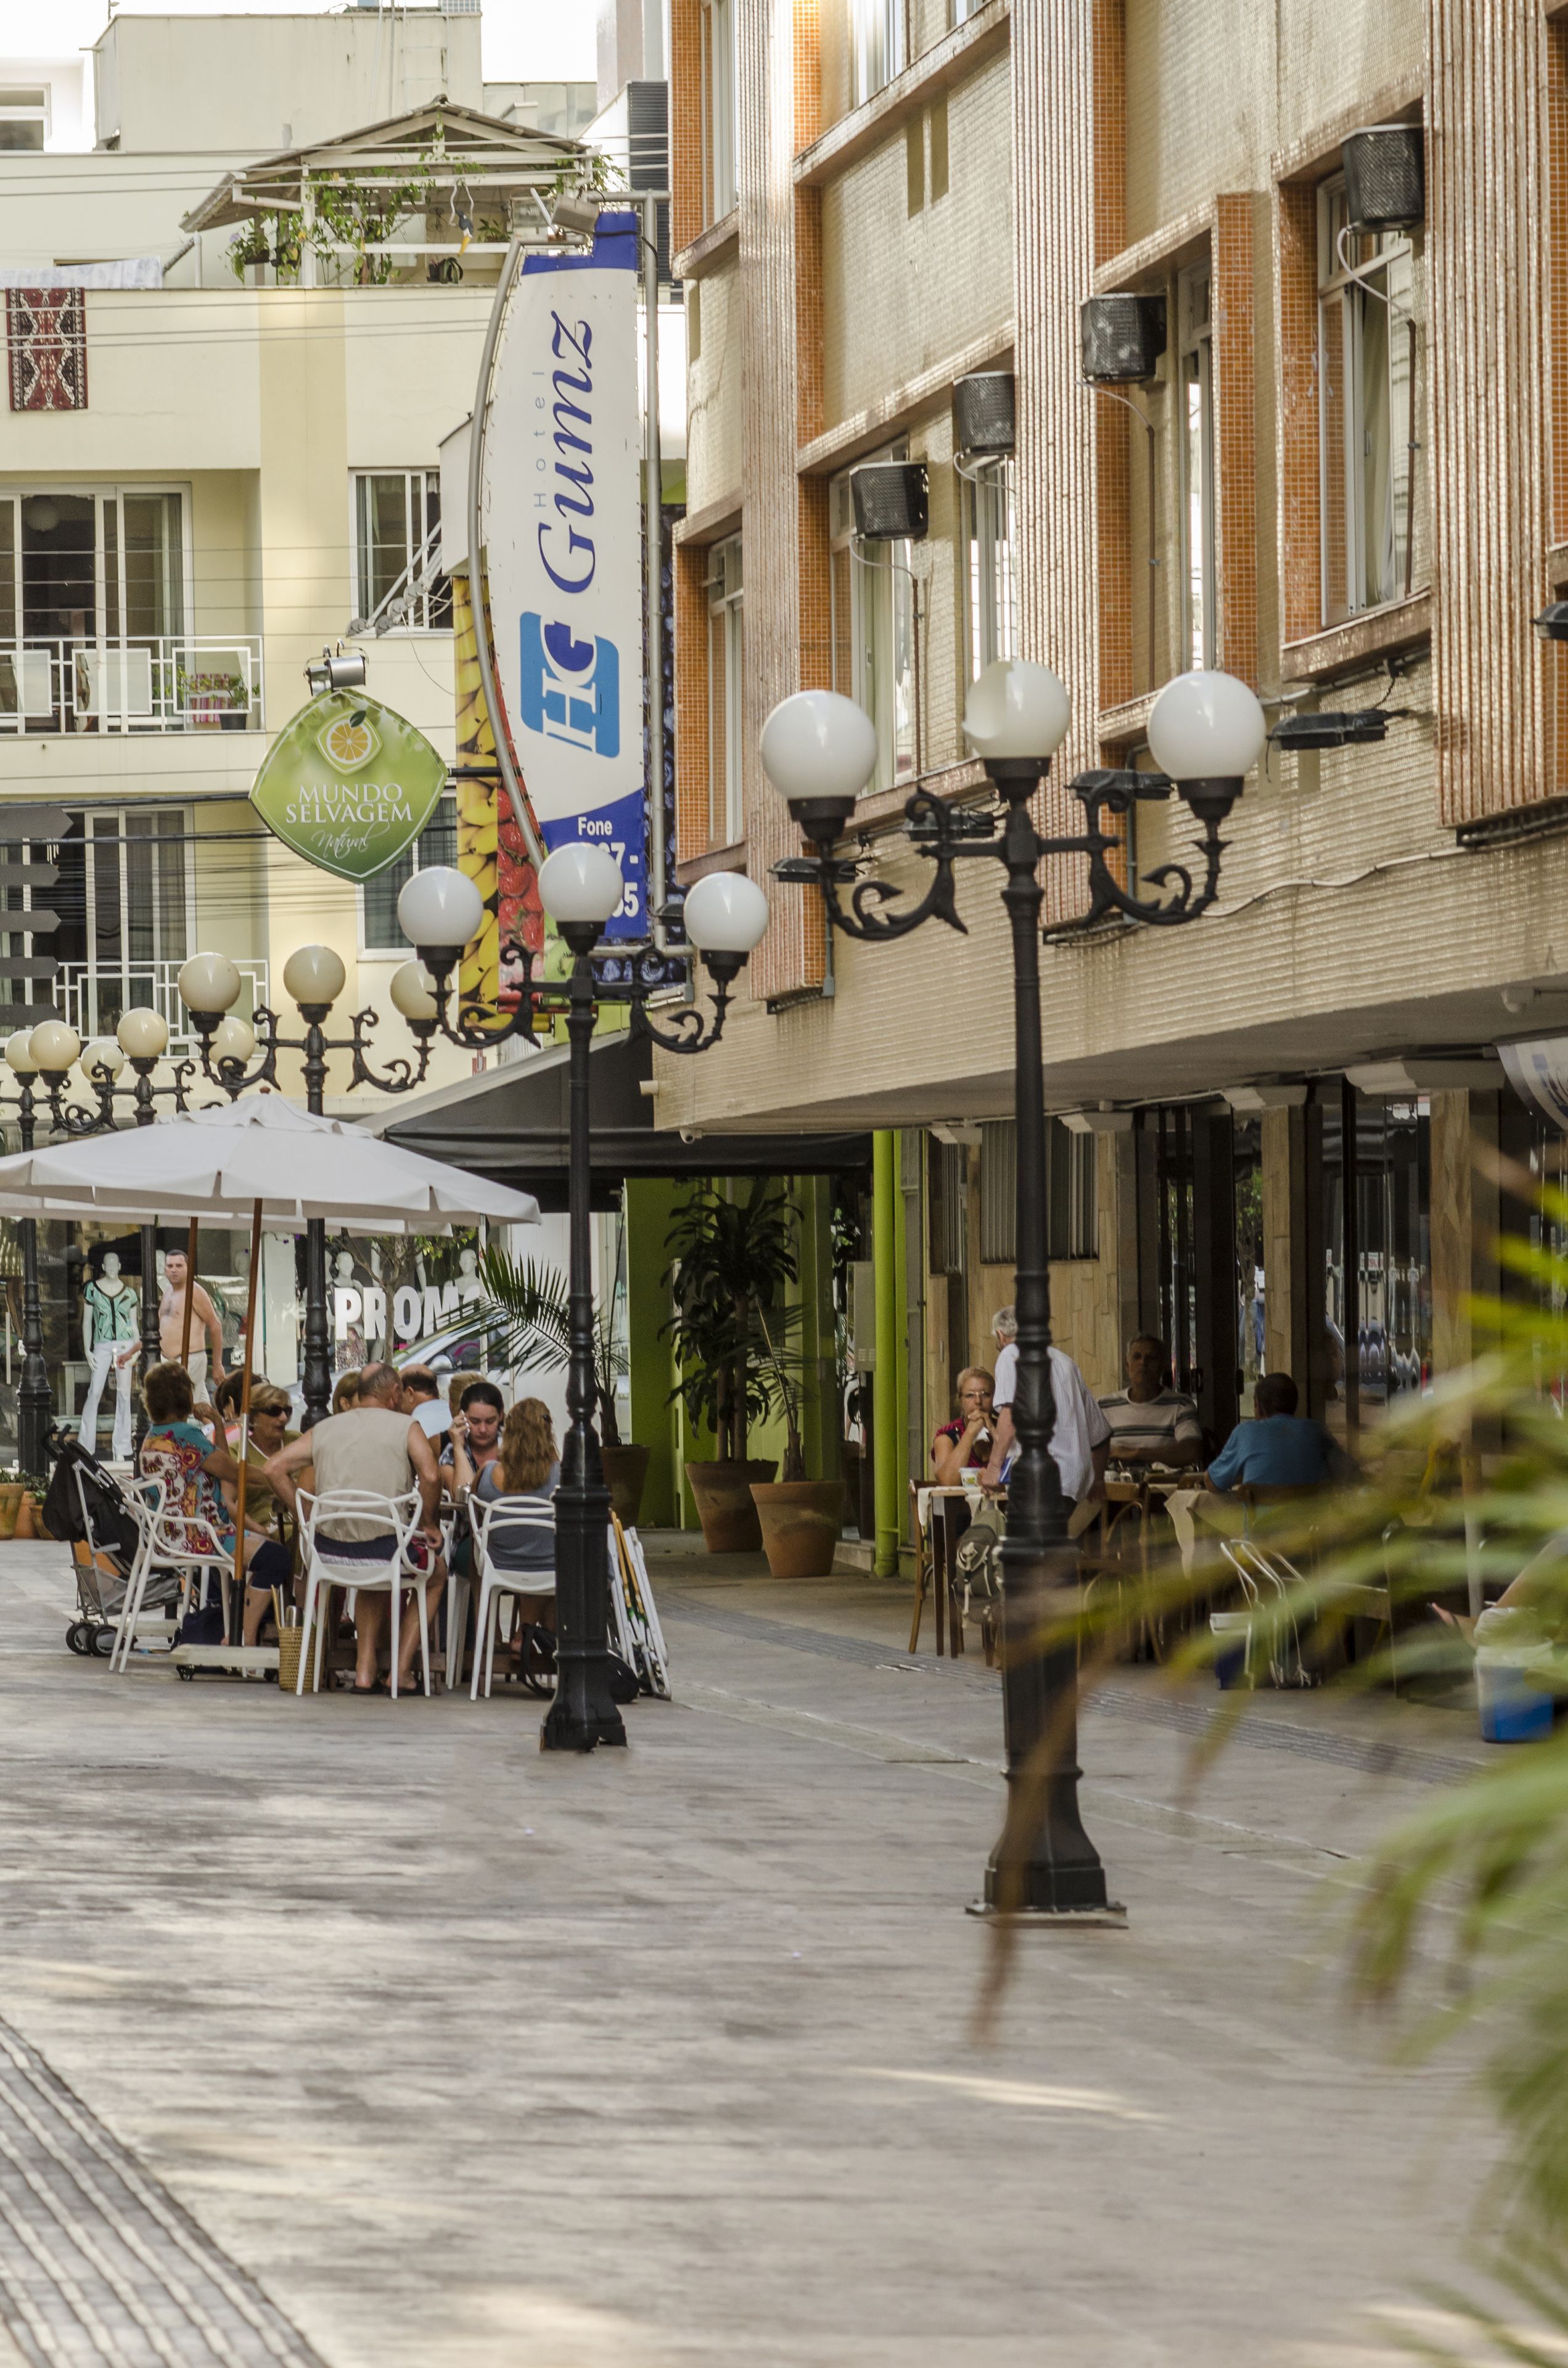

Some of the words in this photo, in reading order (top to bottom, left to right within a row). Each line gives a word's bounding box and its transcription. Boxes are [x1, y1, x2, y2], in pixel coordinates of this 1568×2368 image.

[533, 371, 547, 508] Hotel
[538, 310, 596, 594] Gumz
[298, 783, 403, 804] MUNDO
[285, 802, 414, 824] SELVAGEM
[578, 816, 613, 836] Fone
